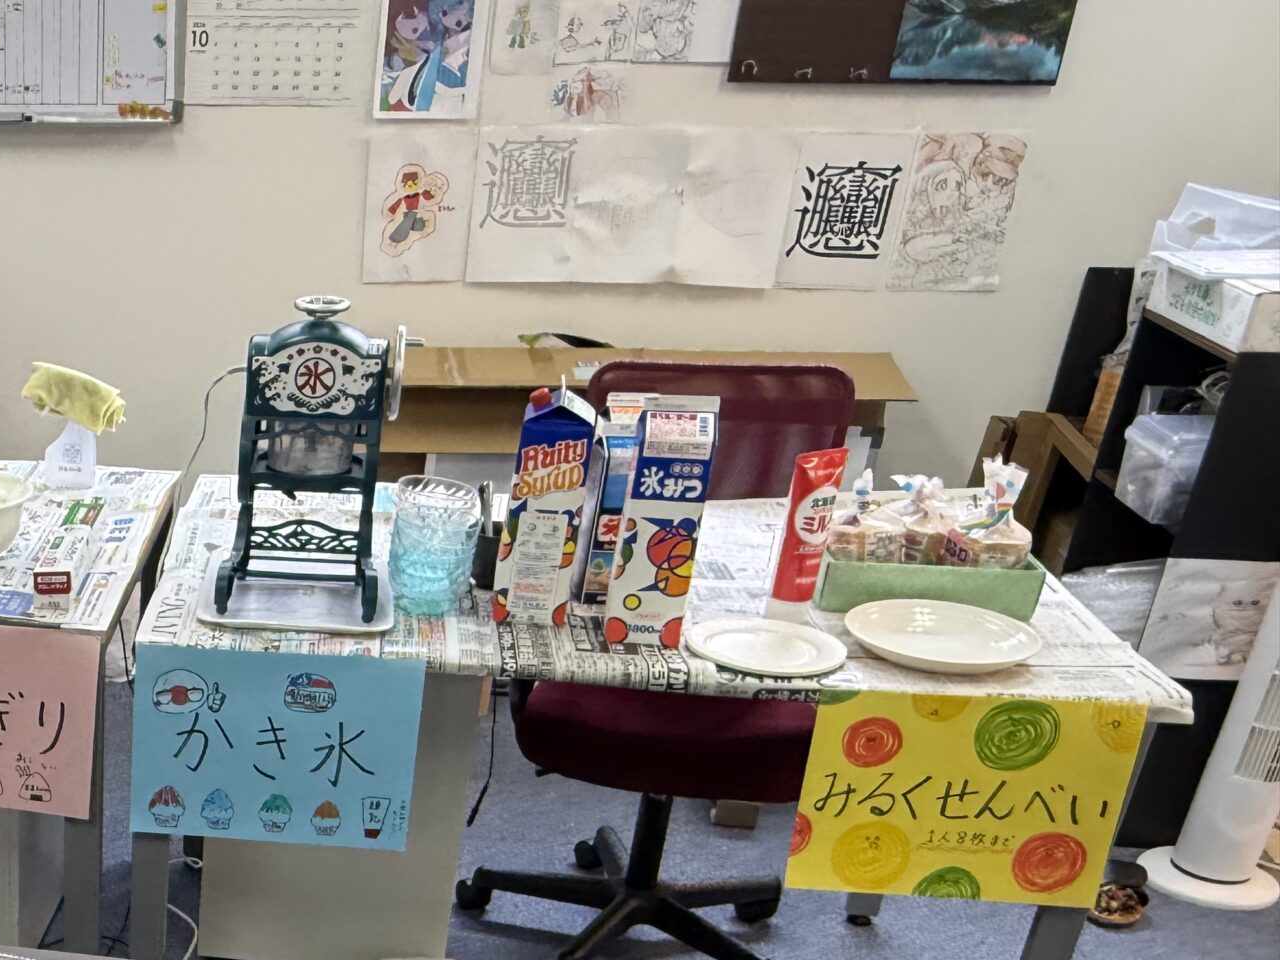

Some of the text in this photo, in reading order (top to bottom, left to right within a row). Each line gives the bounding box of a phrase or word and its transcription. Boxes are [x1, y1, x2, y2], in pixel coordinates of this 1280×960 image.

[191, 30, 210, 48] 10
[296, 360, 333, 396] 氷
[520, 438, 588, 474] Fruity
[517, 462, 585, 499] Syrup
[639, 465, 704, 500] 氷みつ
[172, 712, 376, 789] かき氷
[813, 772, 1109, 826] みるくせんべい
